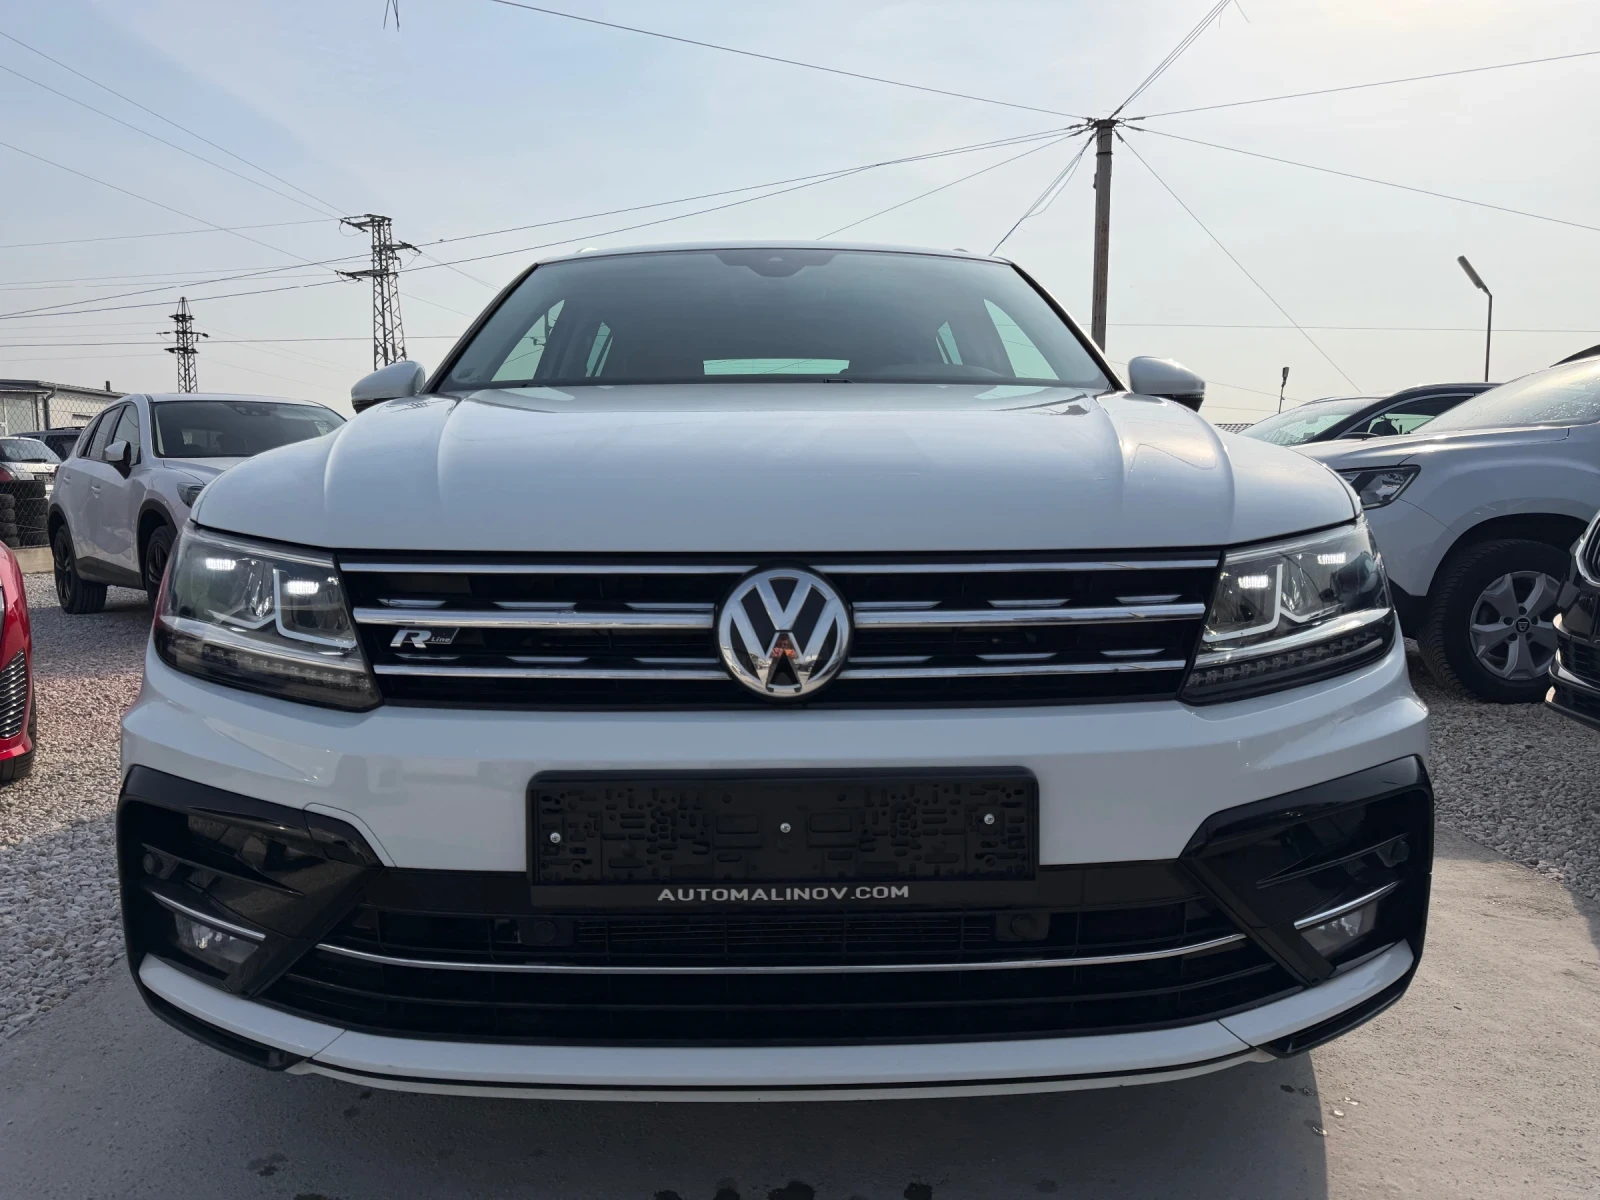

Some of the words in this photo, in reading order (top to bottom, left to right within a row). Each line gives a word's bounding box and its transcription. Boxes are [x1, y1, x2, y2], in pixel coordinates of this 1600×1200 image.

[390, 630, 432, 648] R
[718, 568, 849, 697] VW
[657, 885, 909, 901] AUTOMALINOV.COM
